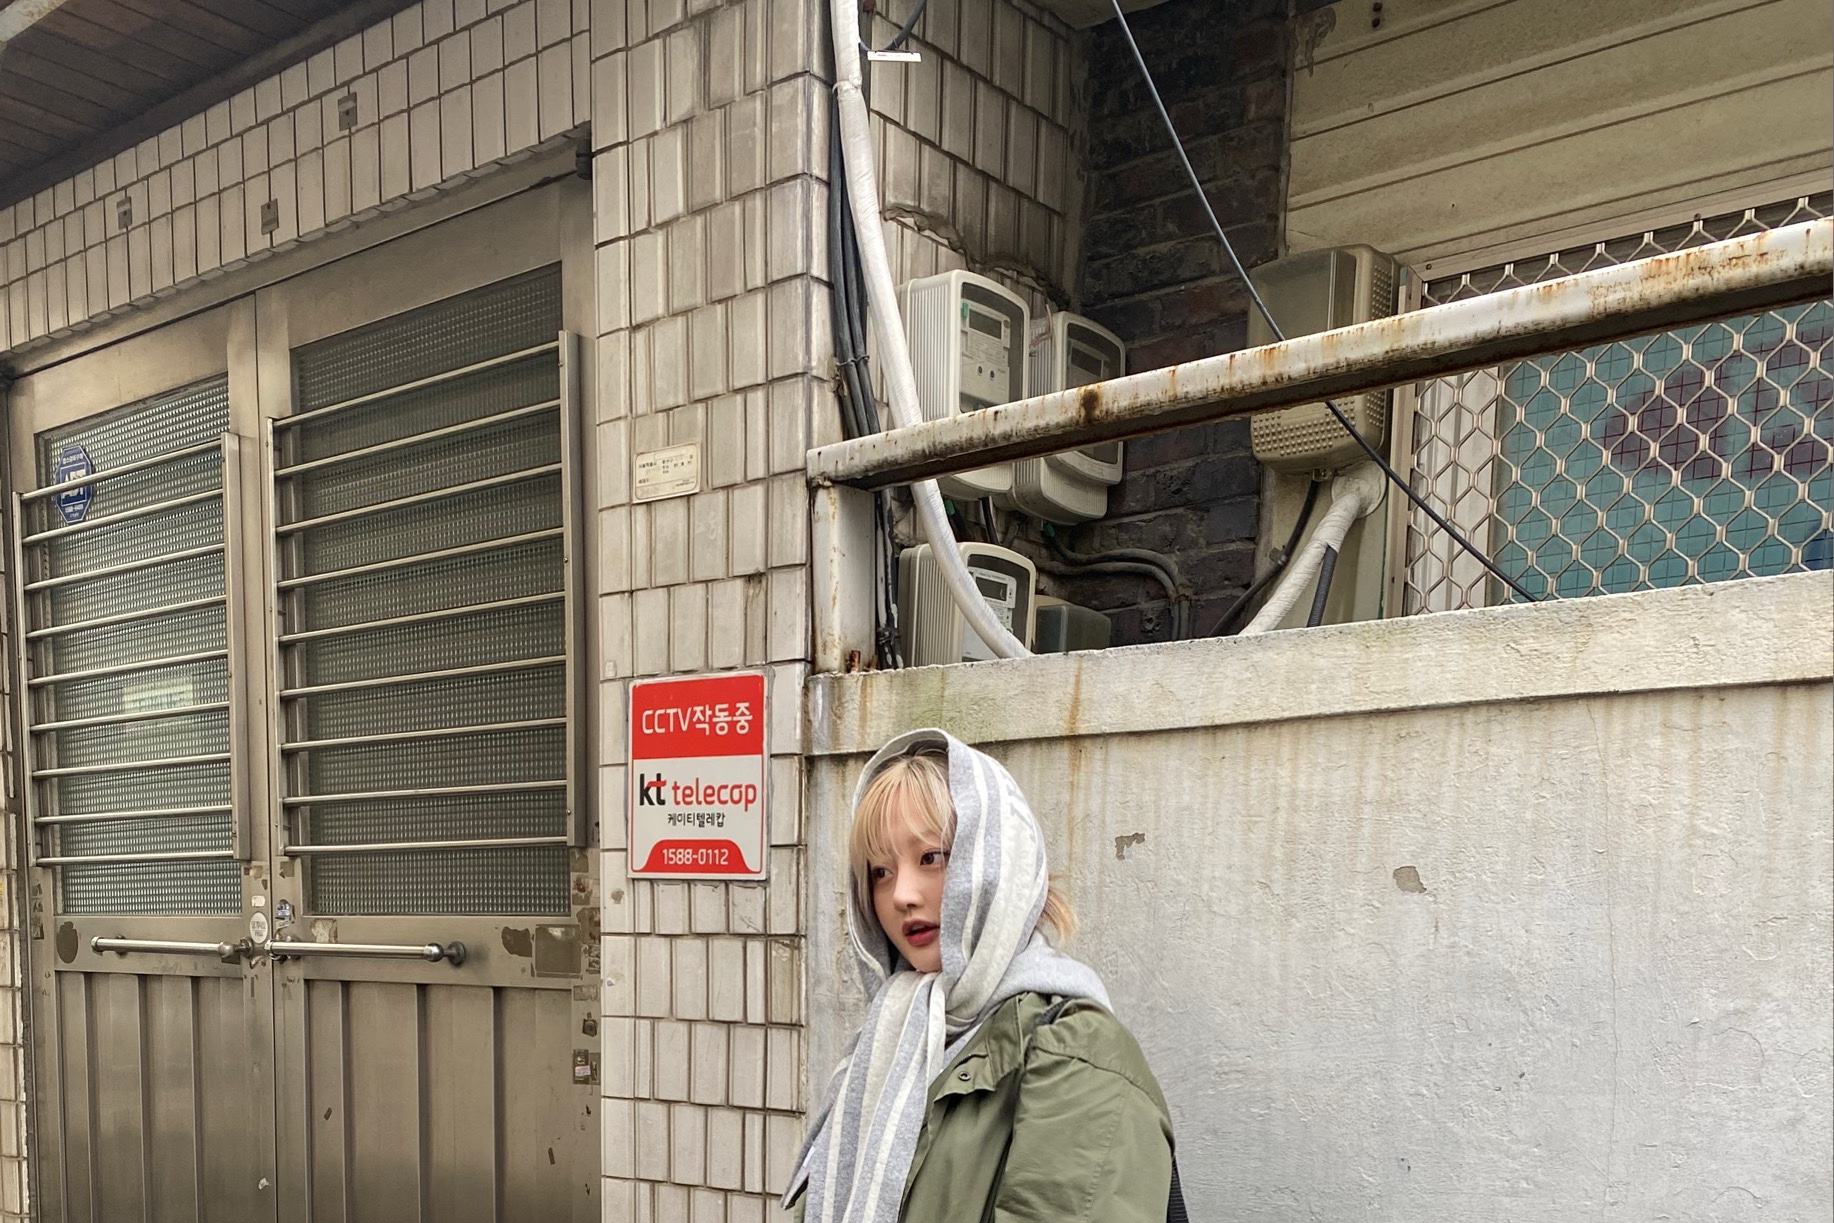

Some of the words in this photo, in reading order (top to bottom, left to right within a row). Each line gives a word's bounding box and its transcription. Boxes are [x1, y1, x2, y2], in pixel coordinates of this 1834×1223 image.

[642, 702, 753, 735] CCTV작동중
[639, 773, 667, 806] kt
[671, 777, 757, 812] telecop
[667, 812, 726, 827] 케이티텔레캅
[662, 848, 729, 865] 1588-0112
